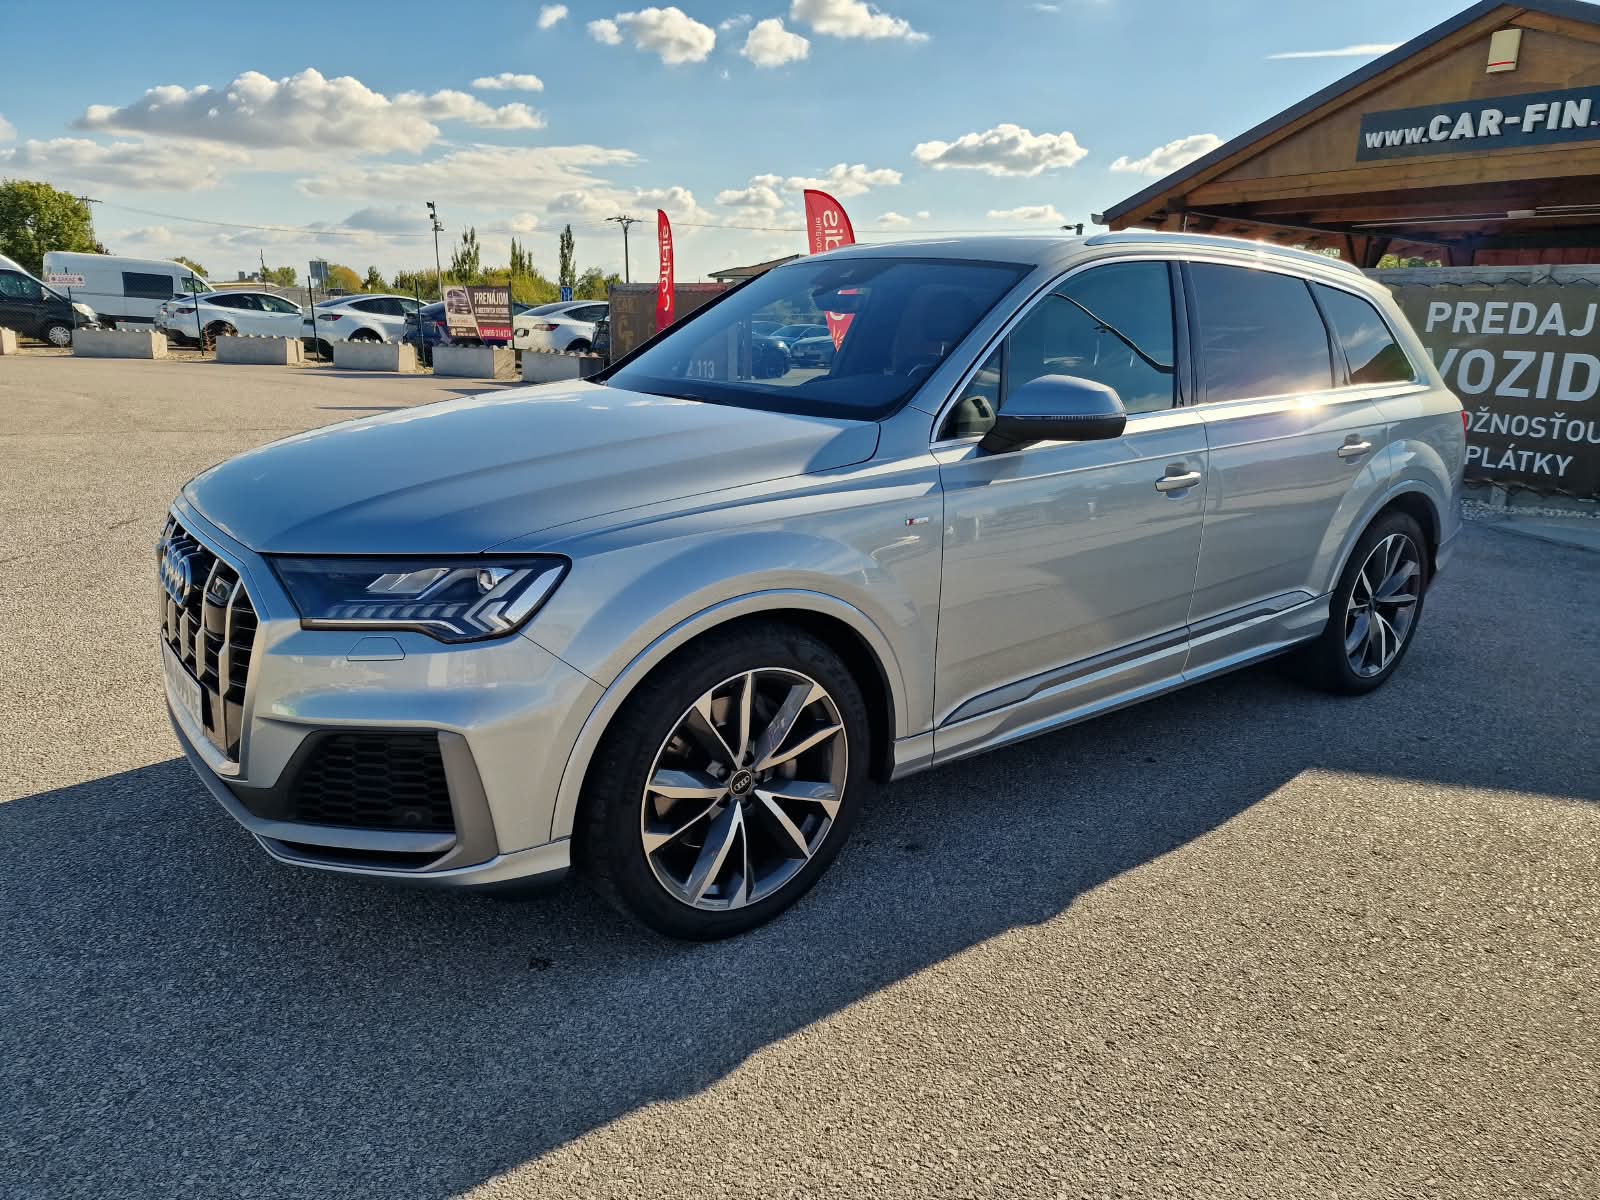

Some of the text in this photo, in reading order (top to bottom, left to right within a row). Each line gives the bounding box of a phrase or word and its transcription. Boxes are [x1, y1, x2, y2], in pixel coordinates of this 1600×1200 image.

[1365, 98, 1600, 149] www.CAR-FIN.
[474, 290, 509, 305] PRENÁJOM
[1425, 301, 1598, 337] PREDAJ
[1464, 443, 1575, 477] PLÁTKY
